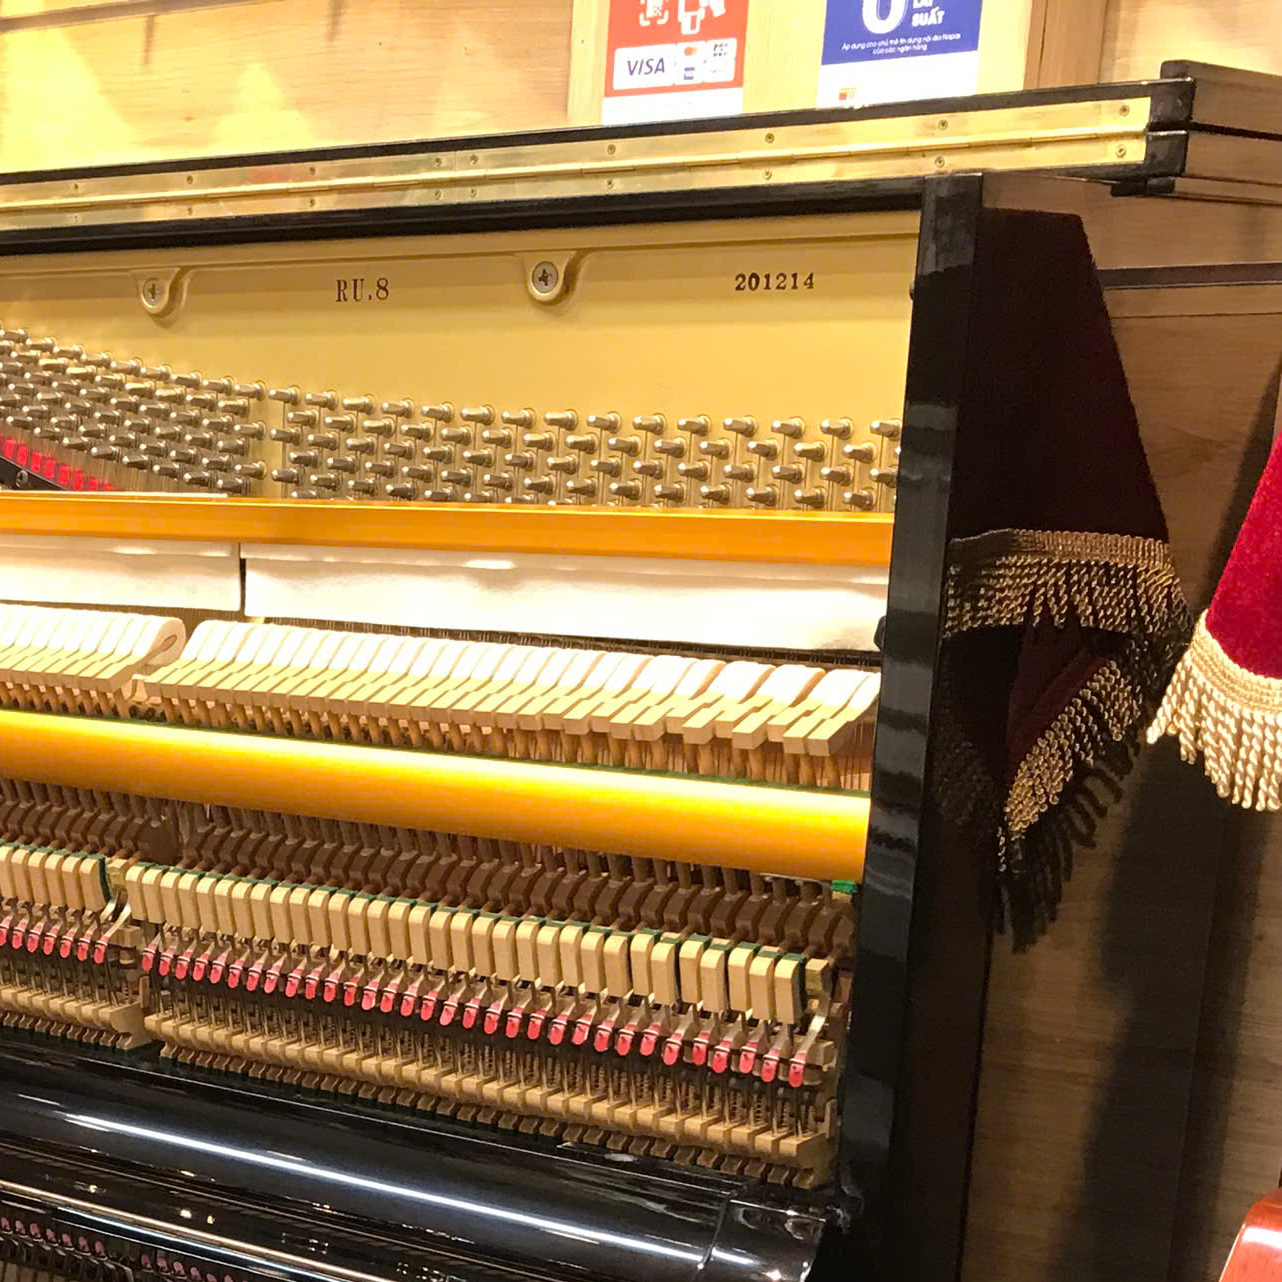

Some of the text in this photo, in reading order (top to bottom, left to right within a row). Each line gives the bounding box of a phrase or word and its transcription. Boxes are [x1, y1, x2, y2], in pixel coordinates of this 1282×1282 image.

[627, 57, 665, 76] VISA
[335, 277, 390, 303] RU.8
[734, 272, 815, 292] 201214
